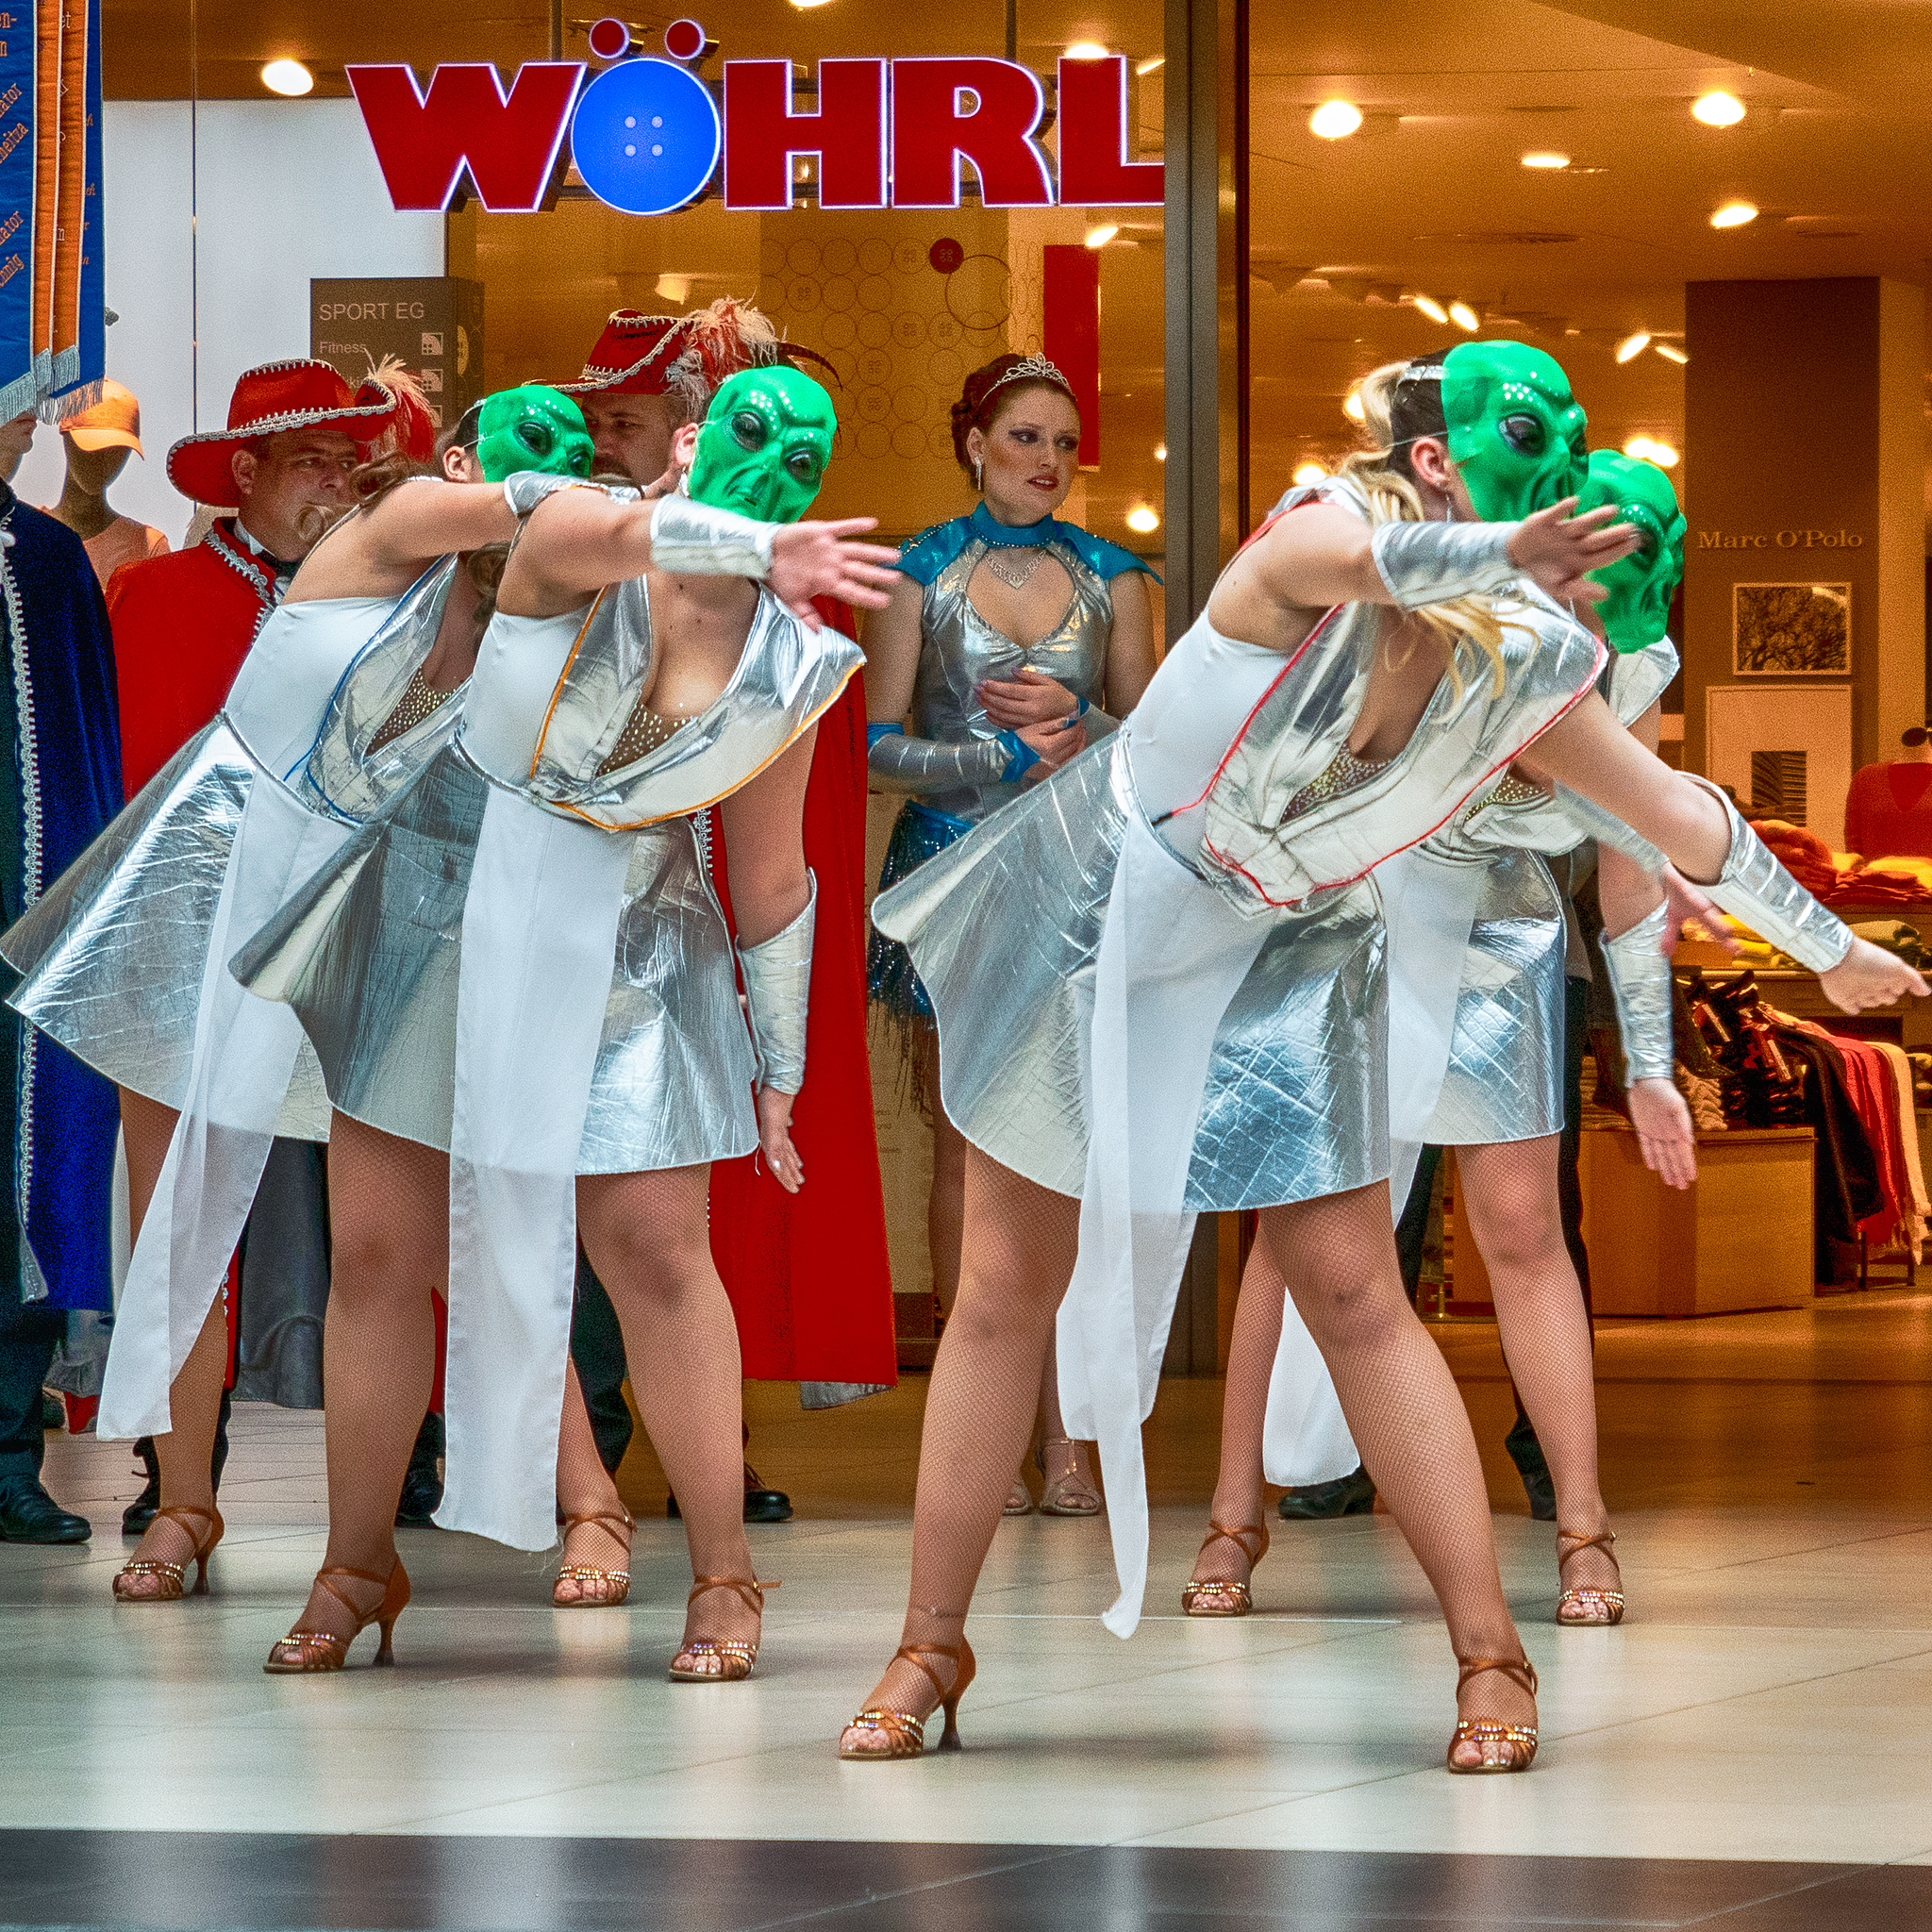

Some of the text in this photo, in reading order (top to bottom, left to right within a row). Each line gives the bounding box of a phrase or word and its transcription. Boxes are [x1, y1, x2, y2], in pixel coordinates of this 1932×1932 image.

[344, 18, 1165, 216] WÖHRL
[319, 302, 425, 321] SPORT EG
[319, 341, 367, 354] Fitness
[1698, 528, 1863, 549] Marc O'Polo
